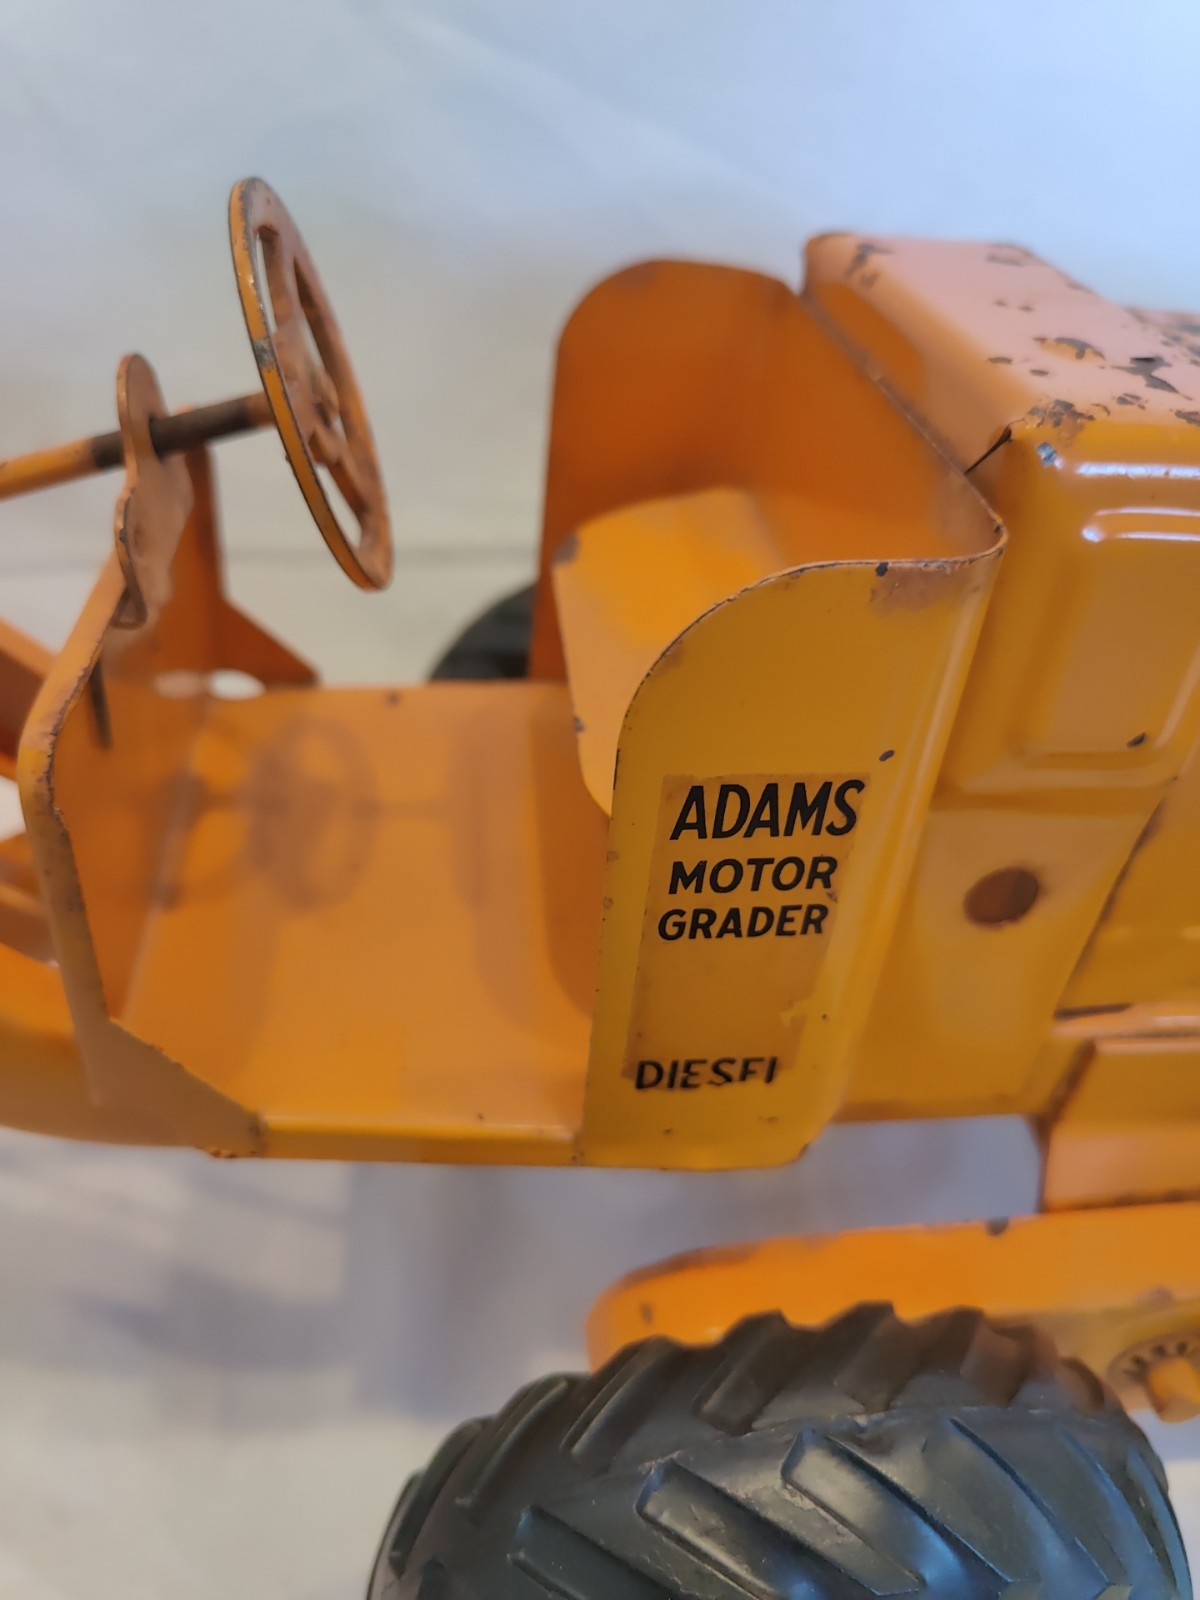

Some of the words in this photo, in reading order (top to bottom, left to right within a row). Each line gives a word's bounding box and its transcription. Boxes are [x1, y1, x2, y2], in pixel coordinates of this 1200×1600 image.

[669, 779, 865, 840] ADAMS
[668, 856, 838, 894] MOTOR
[658, 904, 829, 941] GRADER
